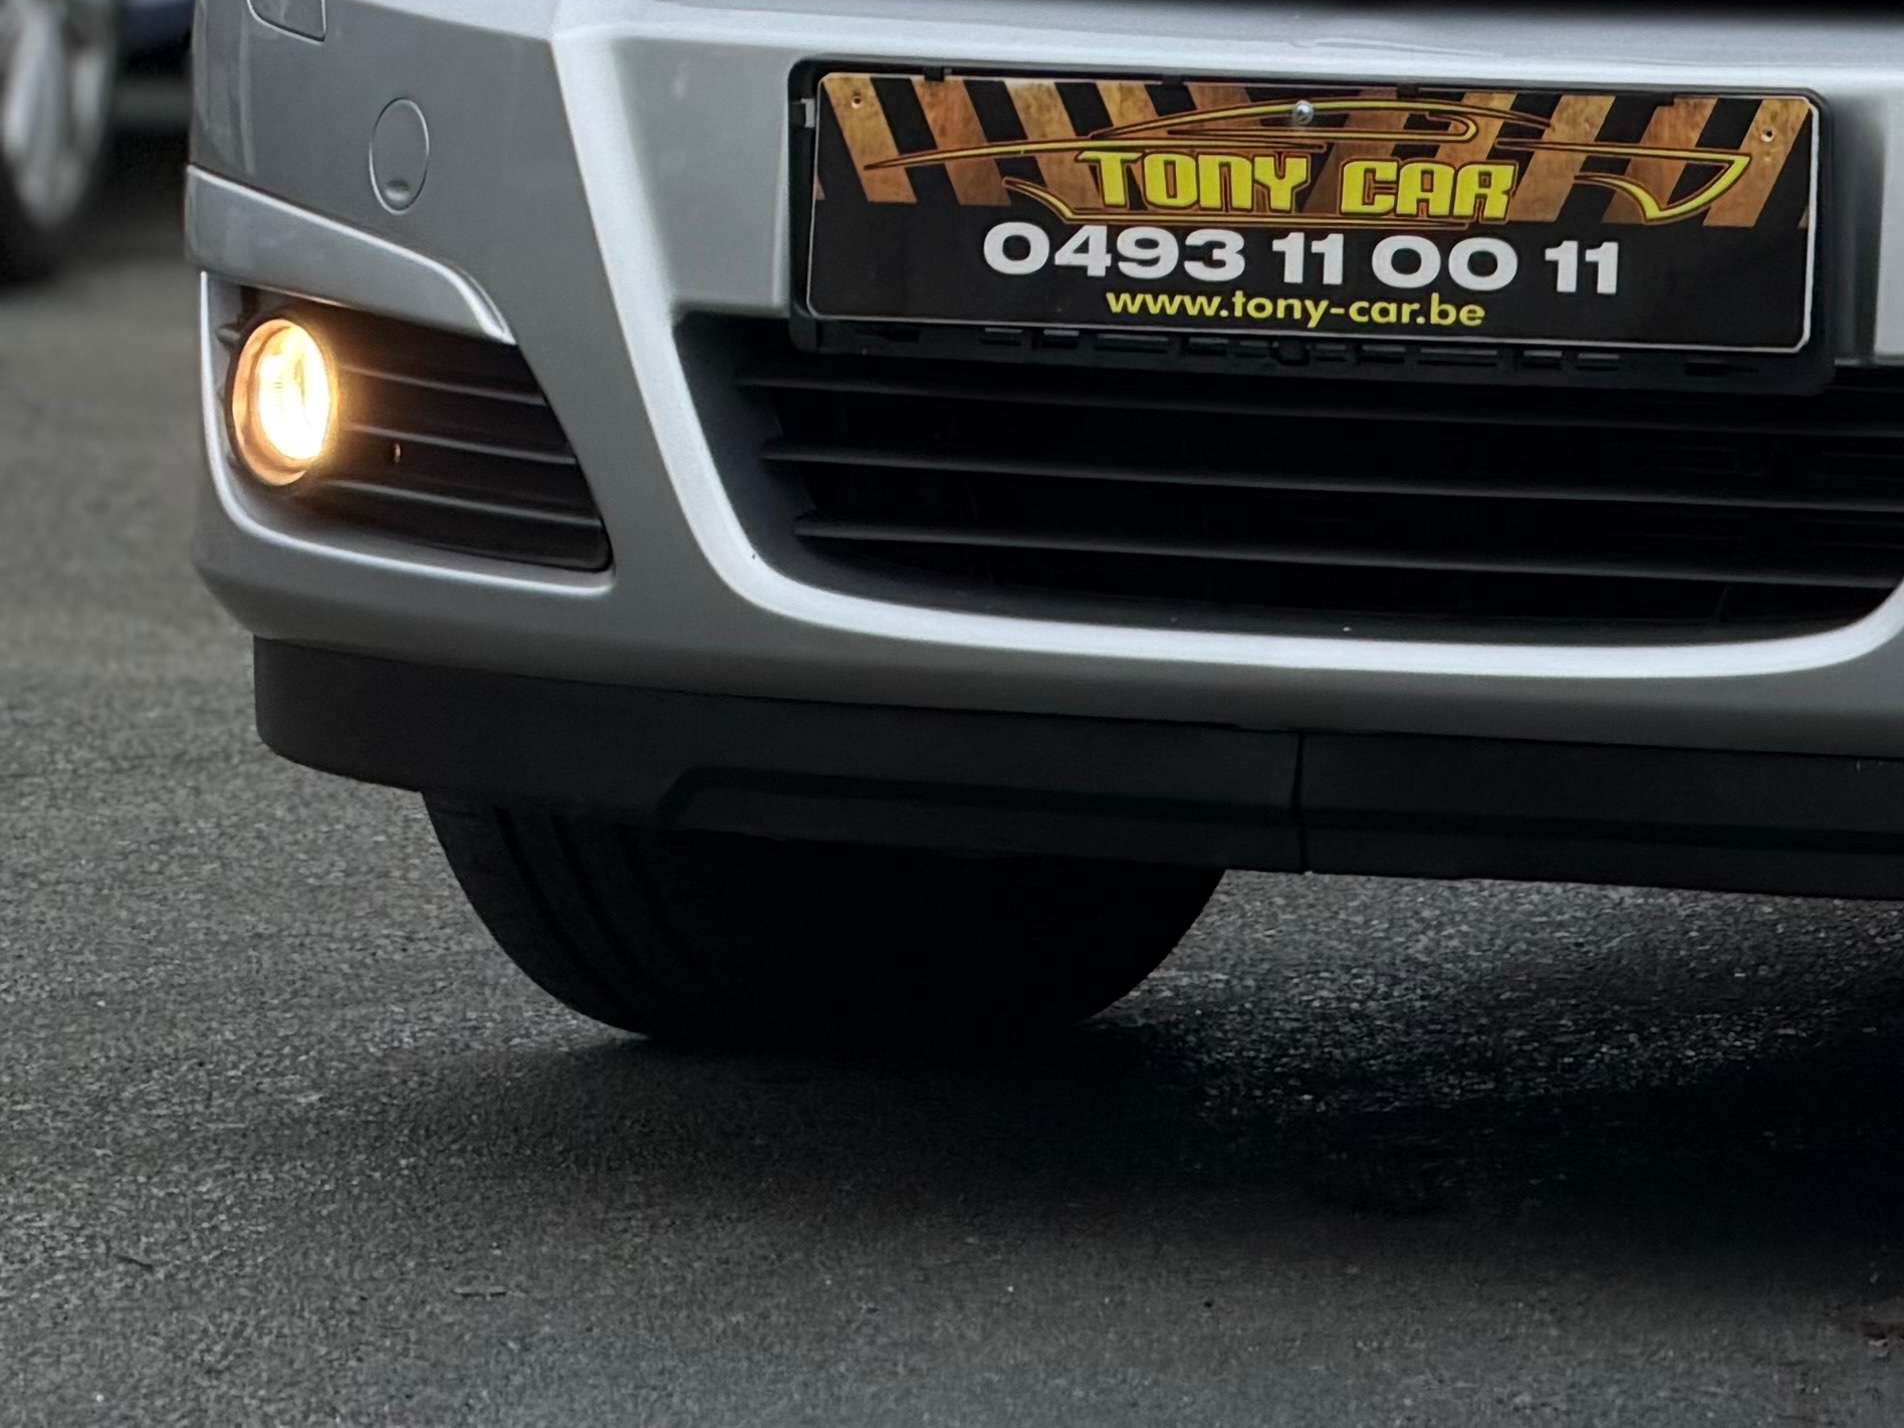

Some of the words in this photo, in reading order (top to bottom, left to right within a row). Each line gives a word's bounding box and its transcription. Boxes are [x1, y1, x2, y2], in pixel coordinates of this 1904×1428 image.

[1078, 148, 1310, 214] TONY
[1339, 157, 1519, 221] CAR
[983, 221, 1247, 284] 0493
[1271, 232, 1345, 286] 11
[1371, 235, 1518, 292] 00
[1544, 240, 1619, 295] 11
[1105, 290, 1486, 328] www.tony-car.be
